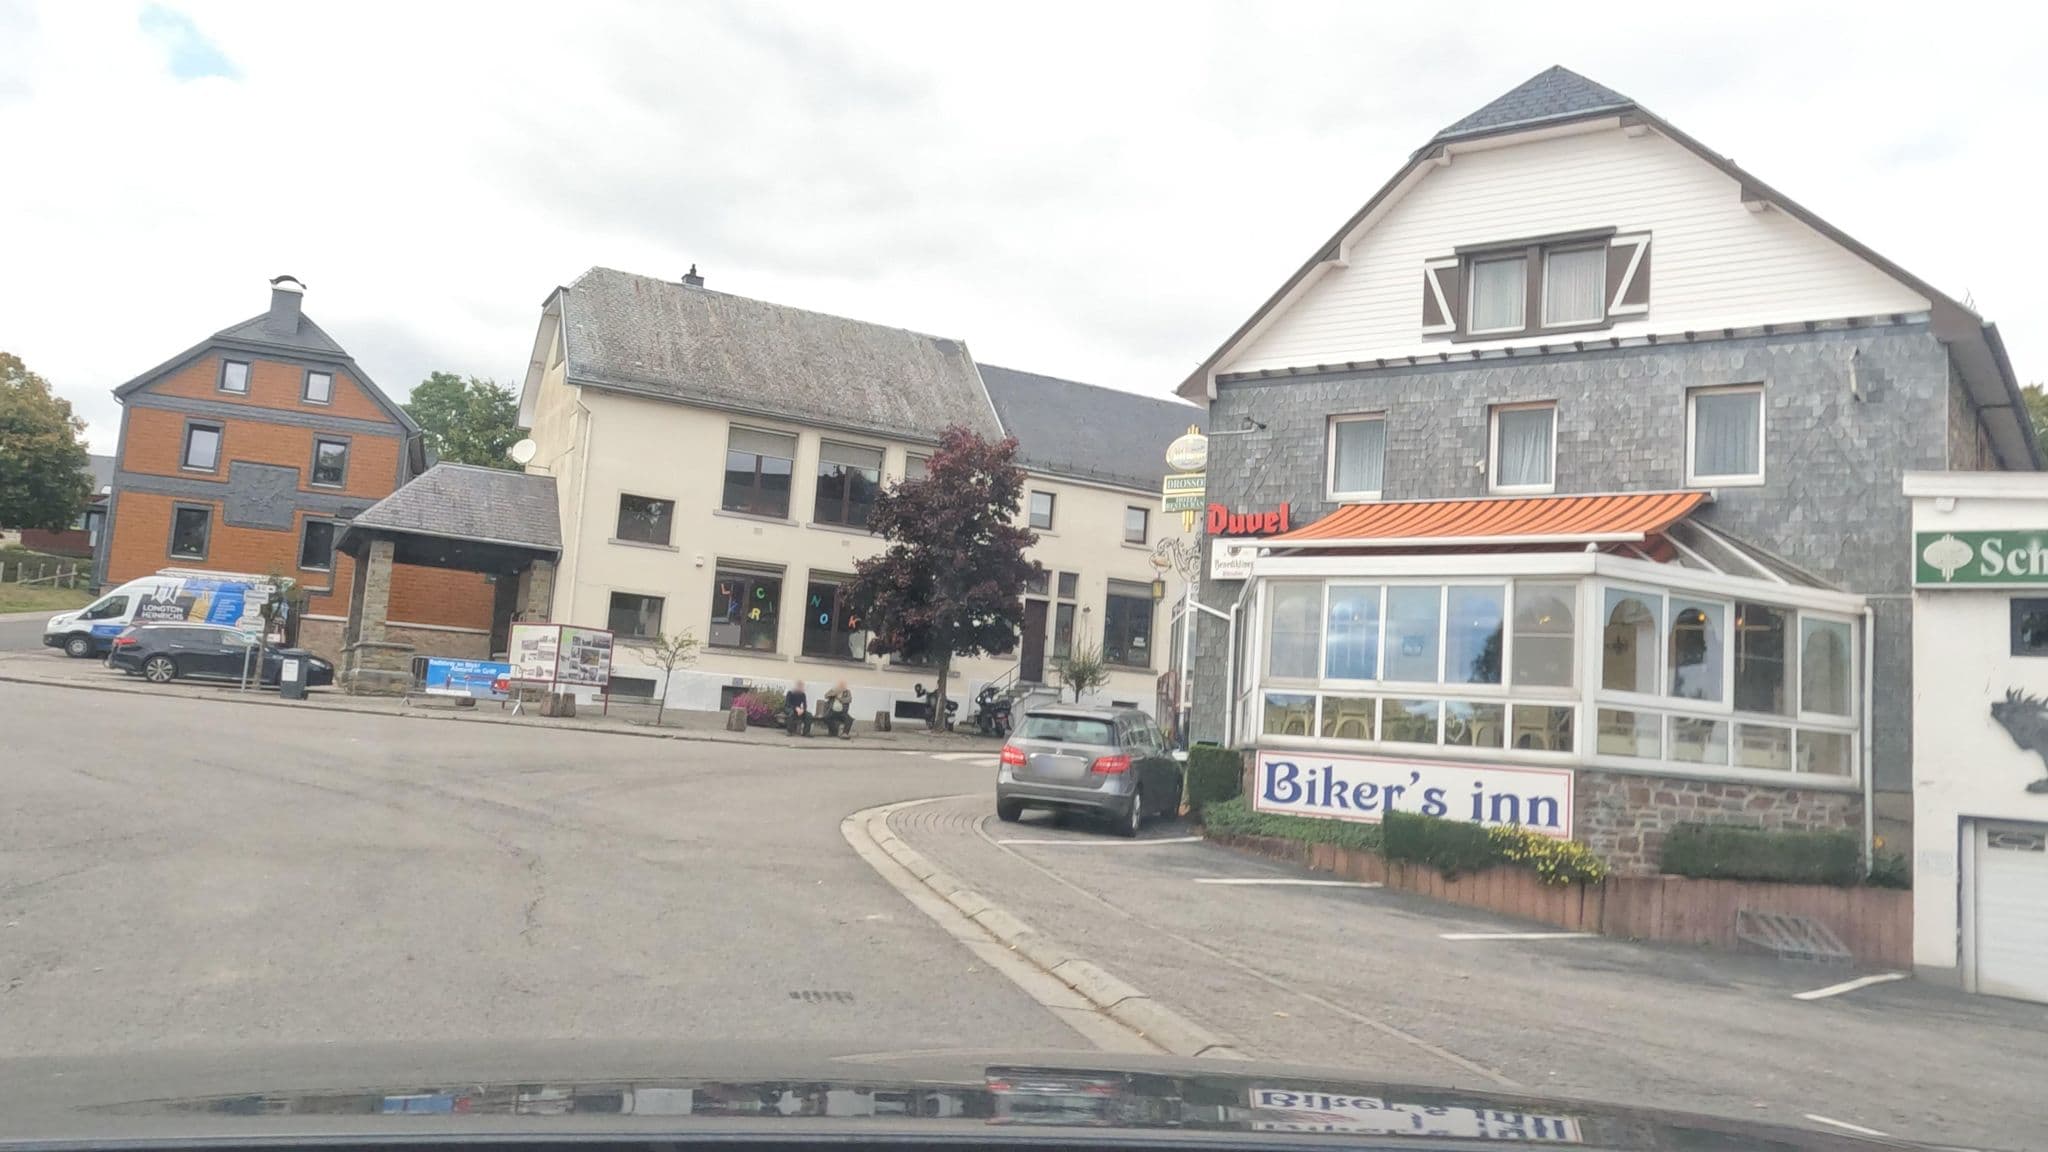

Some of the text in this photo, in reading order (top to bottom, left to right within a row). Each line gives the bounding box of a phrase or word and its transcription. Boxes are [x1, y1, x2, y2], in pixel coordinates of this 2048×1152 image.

[1207, 502, 1290, 535] Duvel
[1263, 761, 1560, 828] Biker's inn
